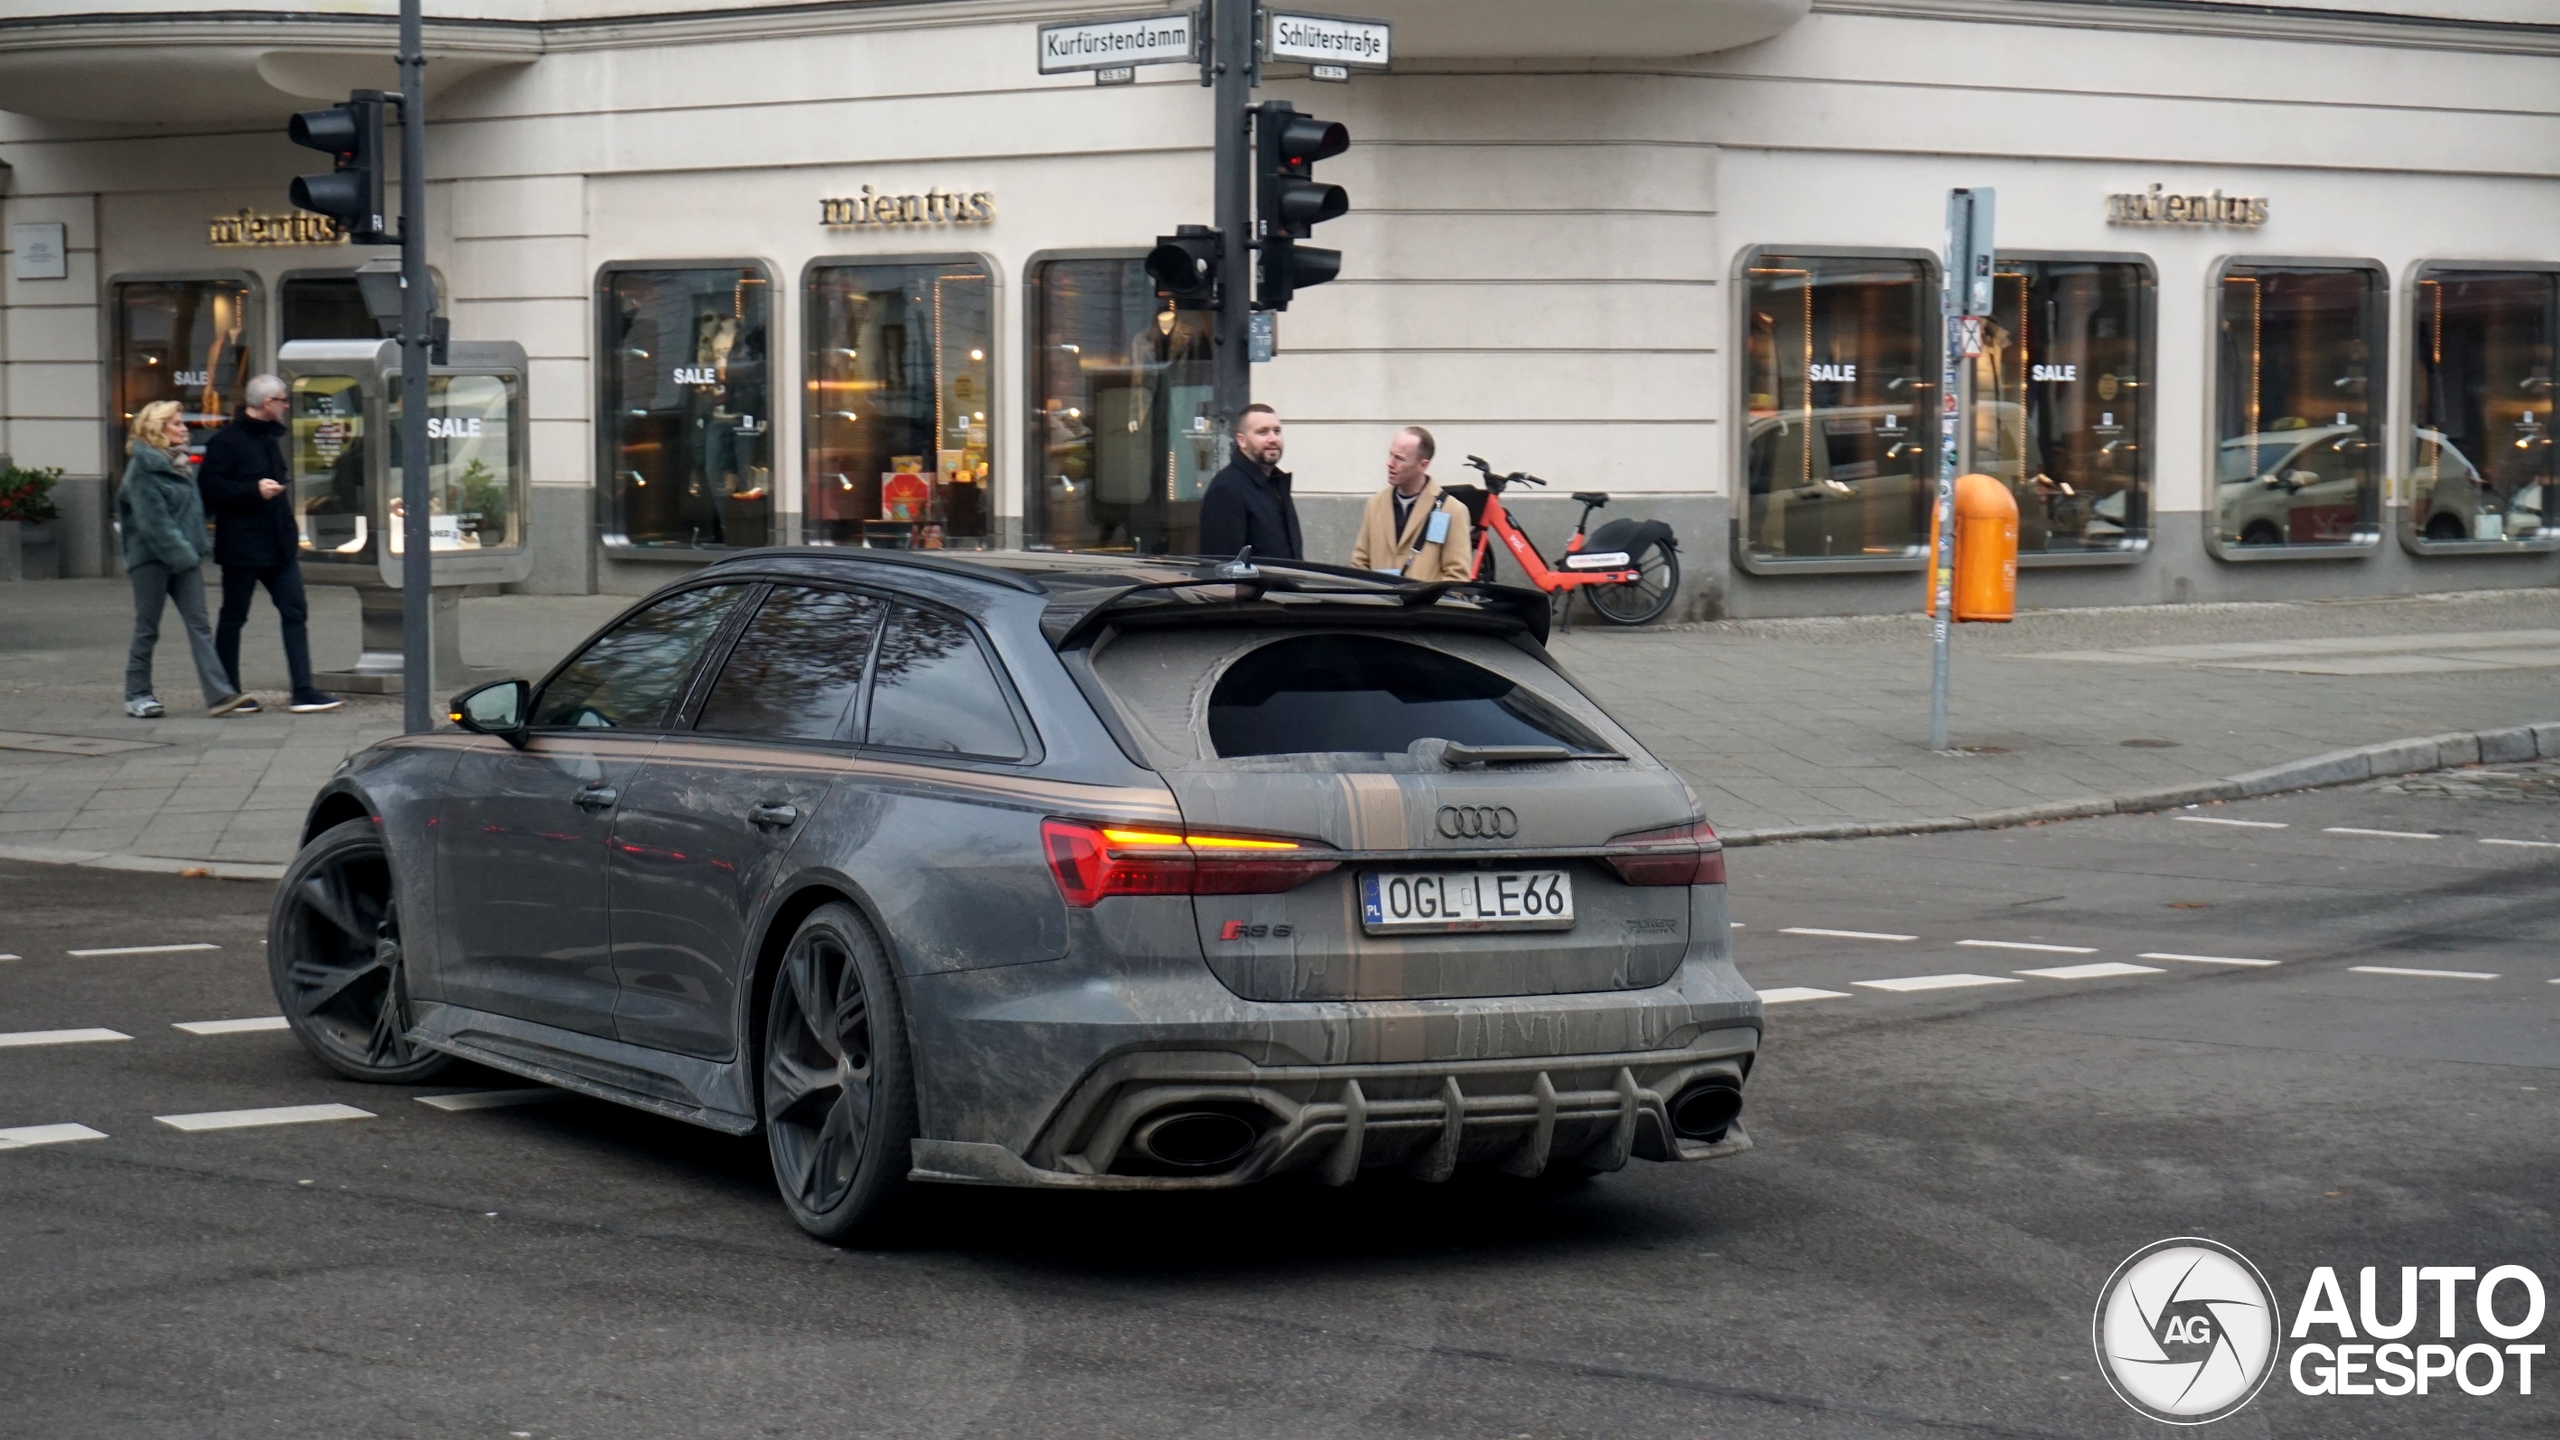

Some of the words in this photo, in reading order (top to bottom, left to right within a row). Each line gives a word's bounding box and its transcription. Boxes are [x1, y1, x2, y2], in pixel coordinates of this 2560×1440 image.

[1048, 25, 1186, 57] Kurfürstendamm
[1279, 22, 1381, 57] Schlüterstraße
[819, 184, 996, 229] mientus
[2105, 182, 2270, 227] mientus
[173, 370, 208, 385] SALE
[673, 367, 716, 384] SALE
[1810, 363, 1856, 381] SALE
[2032, 363, 2076, 381] SALE
[427, 418, 481, 438] SALE
[1389, 876, 1460, 918] OGL
[1474, 875, 1564, 918] LE66
[1366, 904, 1380, 916] PL
